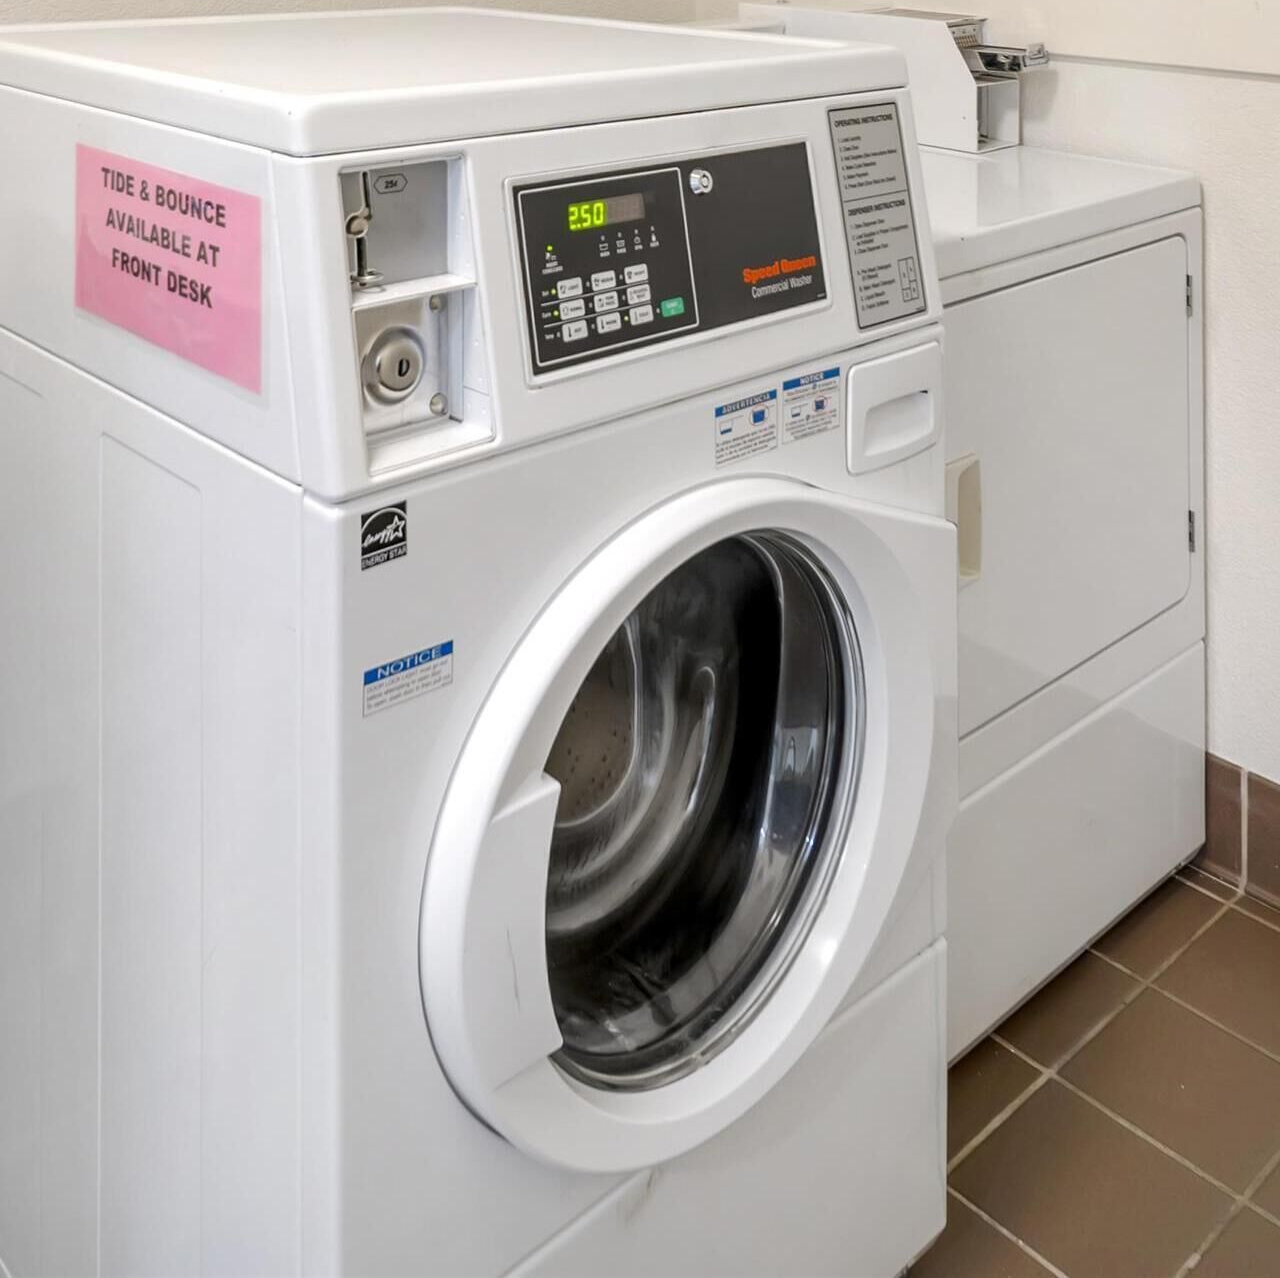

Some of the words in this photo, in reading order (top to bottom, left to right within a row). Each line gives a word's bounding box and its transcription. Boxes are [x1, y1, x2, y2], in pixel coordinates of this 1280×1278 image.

[101, 166, 135, 197] TIDE
[139, 179, 150, 202] &
[156, 184, 226, 228] BOUNCE
[106, 207, 191, 259] AVAILABLE
[196, 241, 220, 268] AT
[112, 247, 162, 286] FRONT
[167, 270, 213, 309] DESK
[742, 261, 780, 284] Speed
[780, 256, 816, 274] Queen
[751, 279, 789, 299] Commercial
[789, 274, 813, 289] Washer
[800, 372, 824, 386] NOTICE
[361, 551, 389, 569] ENERGY
[389, 544, 407, 560] STAR
[377, 645, 443, 679] NOTICE
